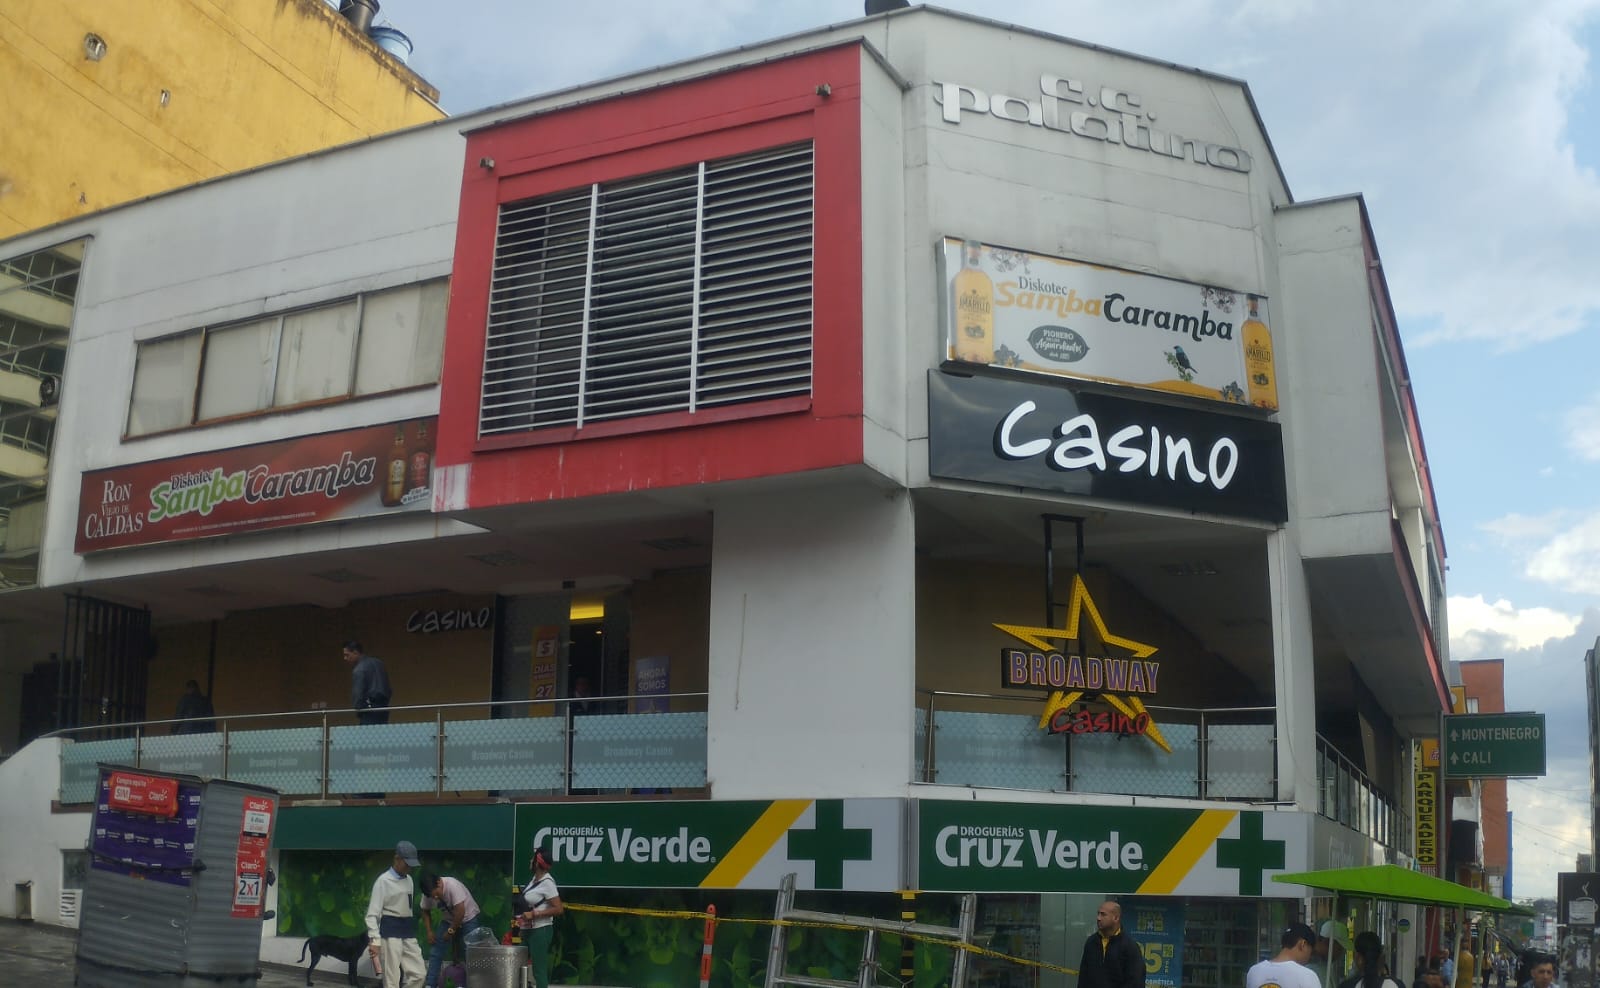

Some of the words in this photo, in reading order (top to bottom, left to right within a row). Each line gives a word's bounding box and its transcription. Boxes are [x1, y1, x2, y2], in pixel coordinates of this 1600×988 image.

[1018, 276, 1068, 297] Diskotec
[995, 281, 1102, 319] Samba
[1103, 292, 1233, 342] Caramba
[171, 469, 214, 491] Diskotec
[245, 451, 377, 504] Caramba
[103, 480, 132, 504] RON
[147, 467, 246, 522] Samba
[85, 512, 144, 539] CALDAS
[1009, 651, 1160, 693] BROADWAY
[638, 679, 667, 691] SOMOS
[1461, 727, 1540, 741] MONTENEGRO
[1463, 752, 1492, 764] CALI
[148, 788, 168, 801] Claro
[249, 800, 268, 810] Claro
[1417, 773, 1434, 862] PARQUEADERO
[552, 825, 604, 836] DROGUERÍAS
[960, 825, 1025, 838] DROGUERÍAS
[533, 826, 603, 862] Cruz
[607, 827, 711, 863] Verde
[935, 825, 1024, 868] Cruz
[1028, 829, 1144, 871] Verde
[240, 859, 260, 870] Claro
[239, 880, 259, 896] 2x1
[1145, 977, 1174, 986] OSMÉTICA
